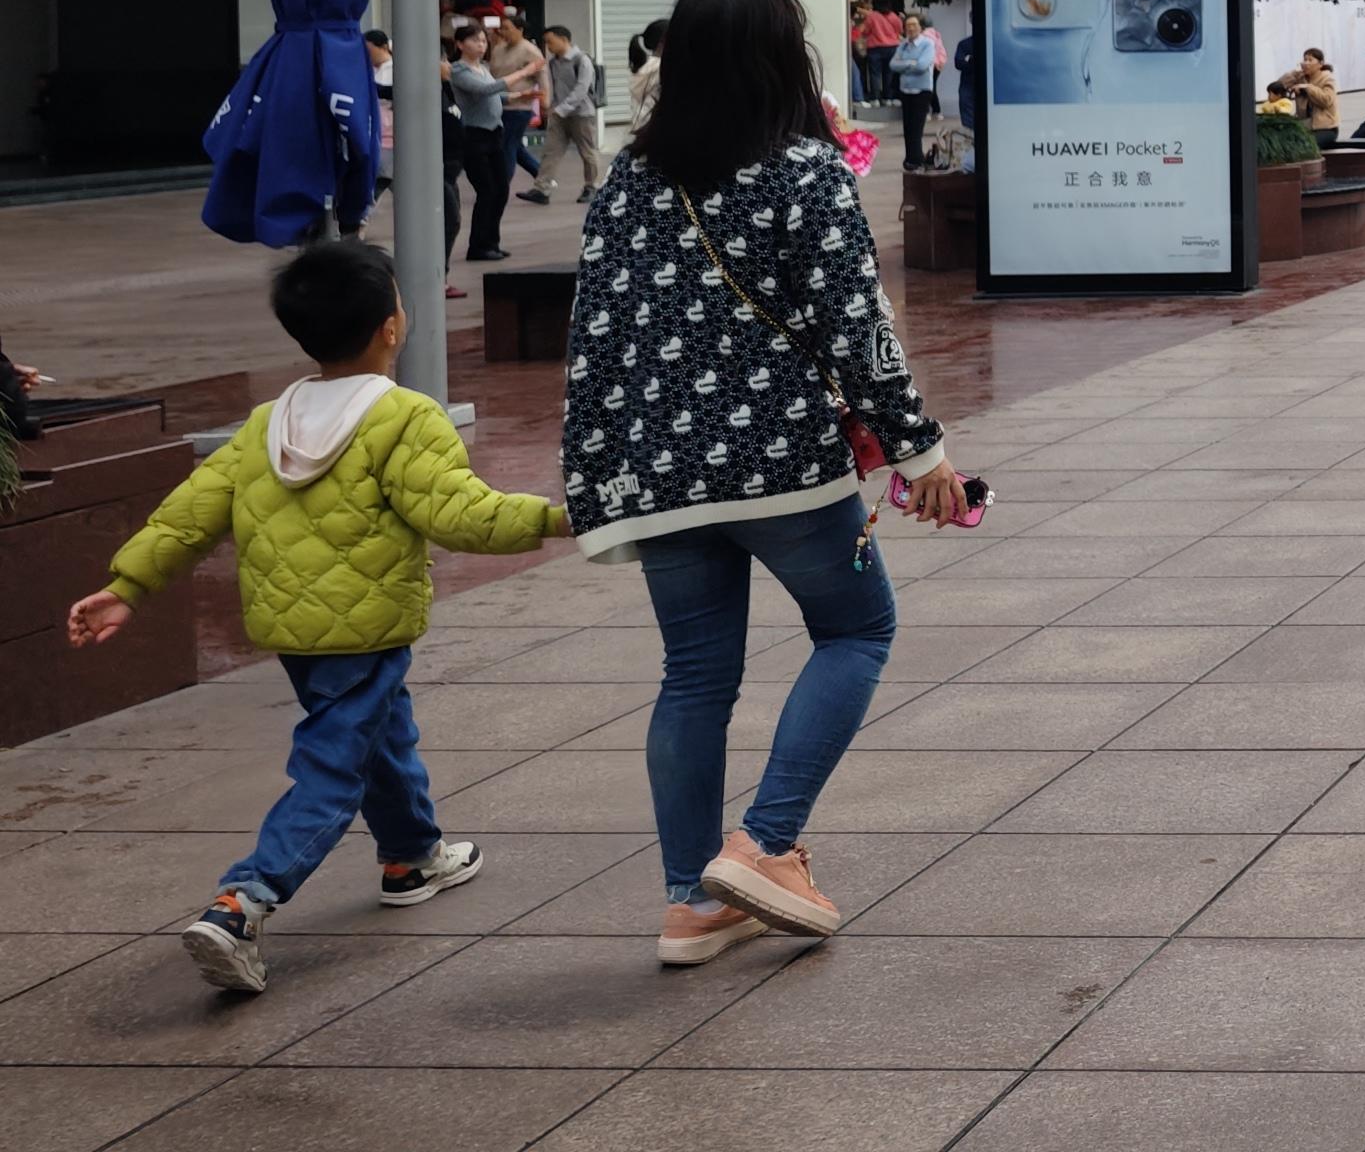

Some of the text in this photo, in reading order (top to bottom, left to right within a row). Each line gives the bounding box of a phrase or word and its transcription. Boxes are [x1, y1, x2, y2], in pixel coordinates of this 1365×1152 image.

[1032, 141, 1183, 156] HUAWEI Pocket 2
[1064, 171, 1152, 187] 正合我意
